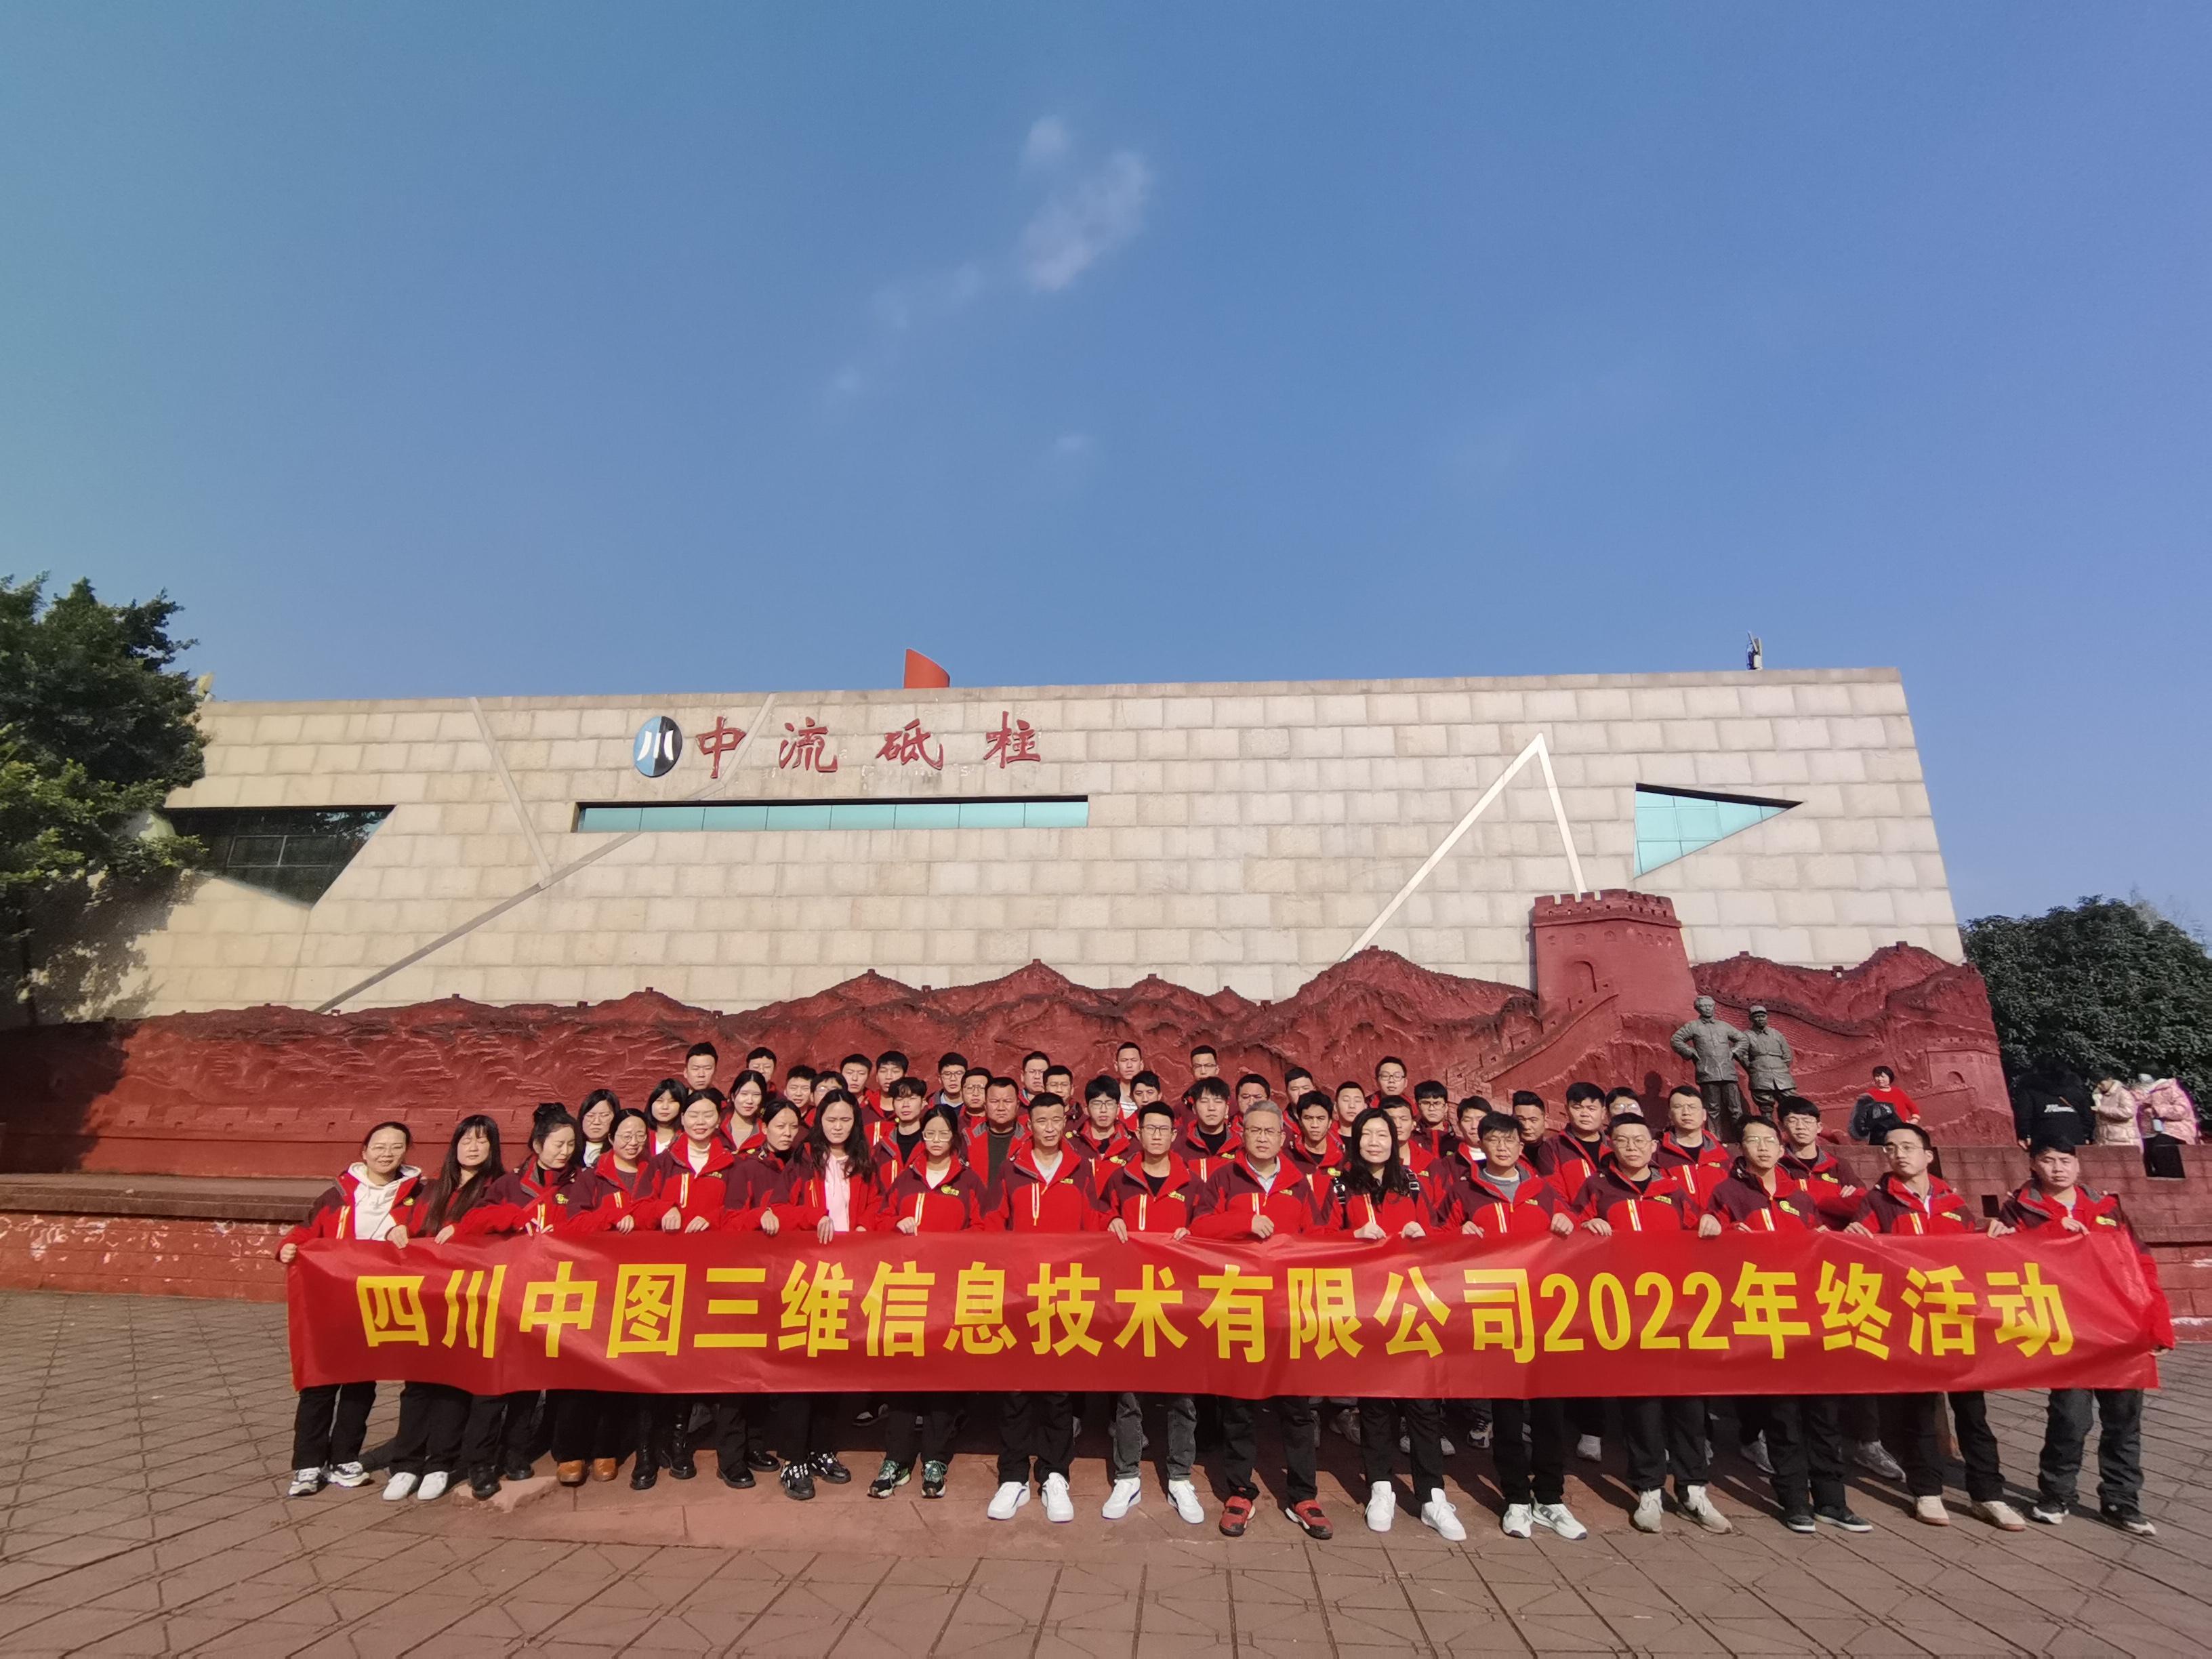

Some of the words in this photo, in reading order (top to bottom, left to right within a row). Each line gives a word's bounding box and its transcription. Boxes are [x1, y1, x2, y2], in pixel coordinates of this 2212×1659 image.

[695, 711, 1042, 779] 中流砥柱
[356, 1261, 2074, 1364] 四川中图三维信息技术有限公司2022年终活动
